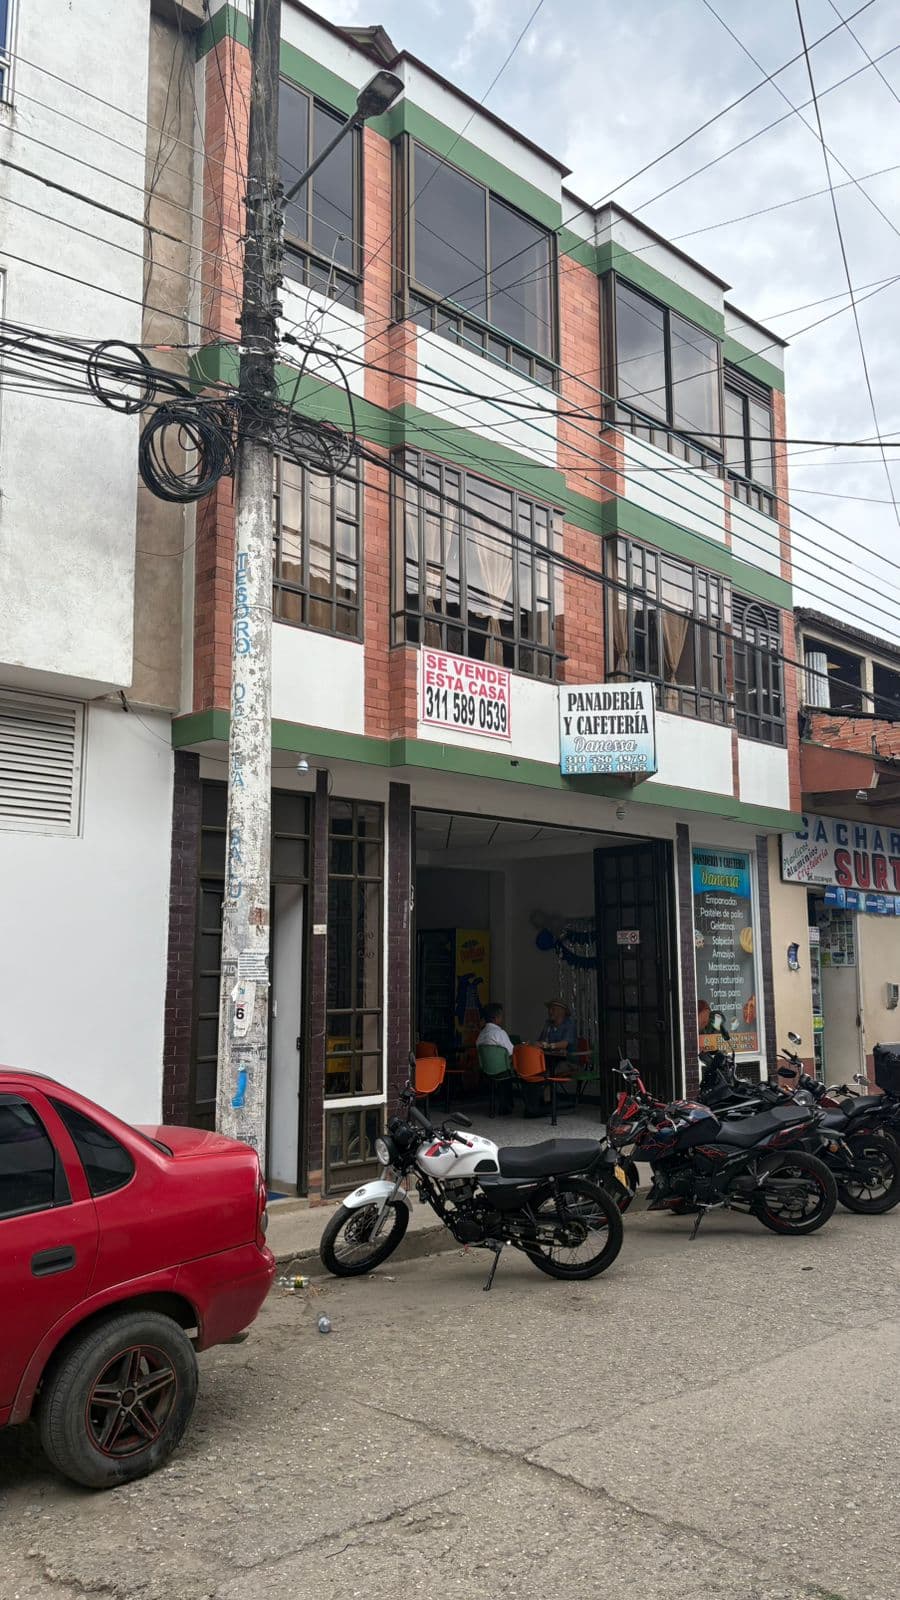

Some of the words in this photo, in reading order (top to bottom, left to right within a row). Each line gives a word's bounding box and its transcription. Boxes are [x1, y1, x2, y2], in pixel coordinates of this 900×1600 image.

[426, 654, 448, 673] SE
[453, 661, 507, 687] VENDE
[426, 670, 464, 692] ESTA
[468, 681, 506, 702] CASA
[567, 687, 644, 712] PANADERÍA
[426, 686, 448, 720] 311
[453, 692, 475, 726] 589
[479, 698, 507, 733] 0539
[563, 716, 572, 736] Y
[576, 711, 649, 735] CAFETERÍA
[573, 736, 638, 753] Danessa
[565, 755, 586, 764] 310
[590, 754, 612, 764] 586
[615, 753, 648, 763] 4979
[834, 848, 900, 893] SURT
[705, 894, 737, 906] Empanadas
[700, 907, 722, 918] Pasteles
[722, 909, 730, 918] de
[710, 920, 735, 931] Gelatinas
[710, 988, 727, 998] Tortas
[236, 1008, 245, 1020] 6
